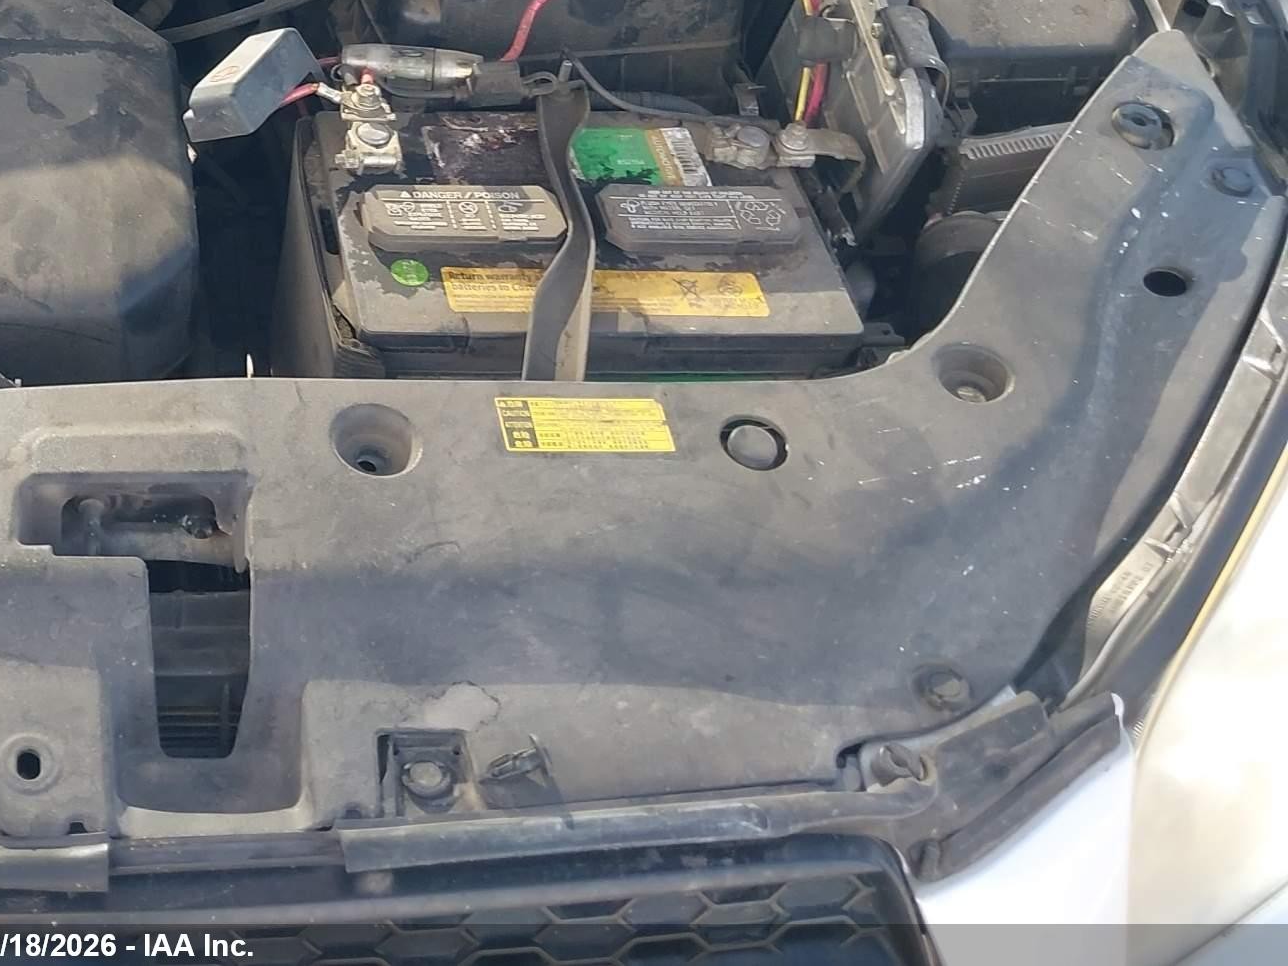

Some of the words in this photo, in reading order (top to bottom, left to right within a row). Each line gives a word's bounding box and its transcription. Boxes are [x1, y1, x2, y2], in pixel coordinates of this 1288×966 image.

[413, 191, 462, 199] DANGER
[474, 191, 520, 199] POISON
[448, 272, 484, 281] Return
